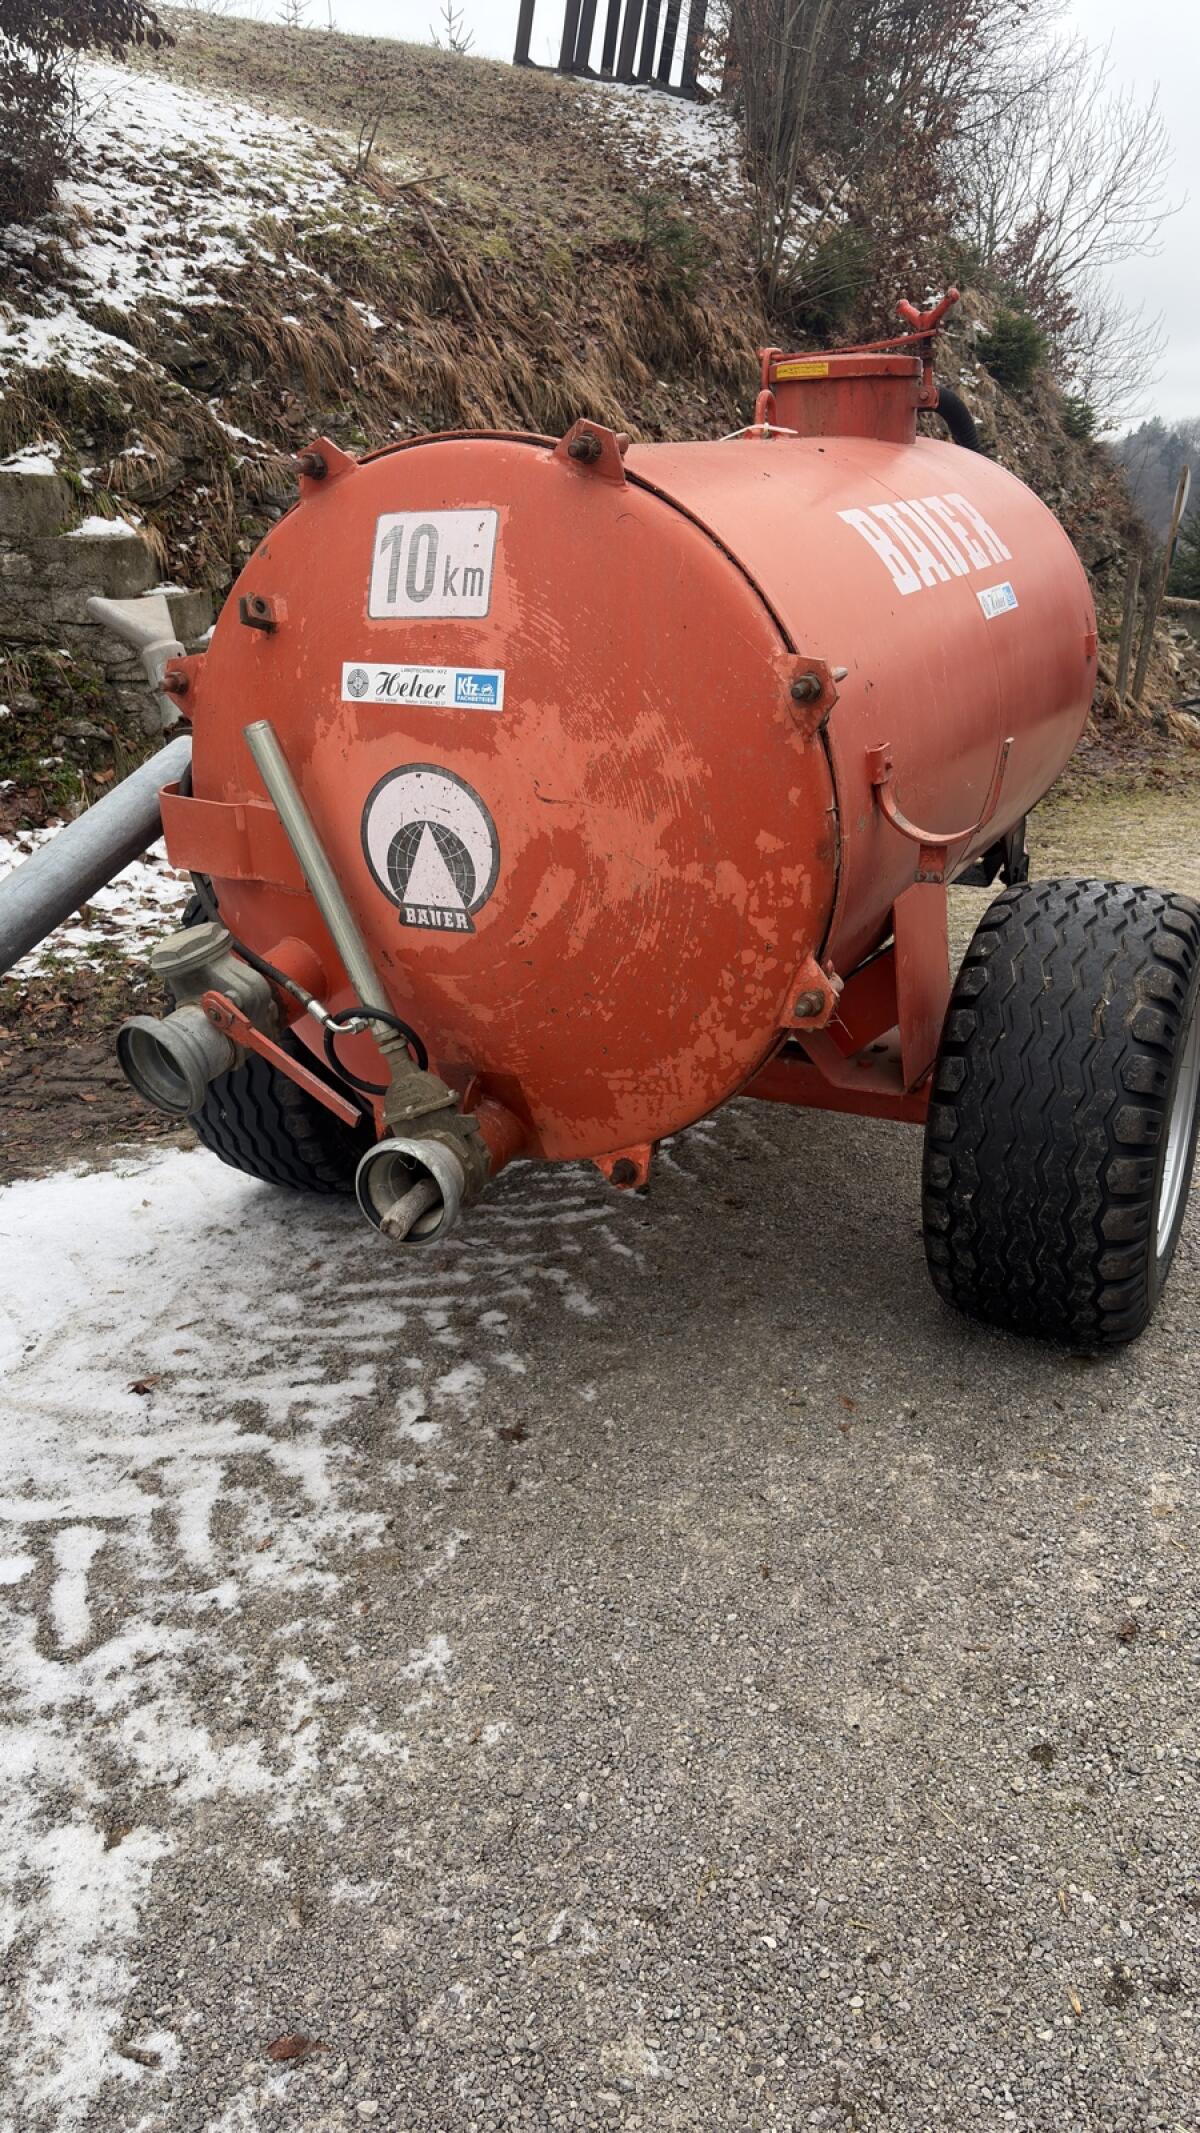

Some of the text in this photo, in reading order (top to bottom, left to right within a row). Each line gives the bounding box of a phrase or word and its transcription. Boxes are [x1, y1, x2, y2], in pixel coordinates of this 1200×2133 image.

[380, 523, 485, 603] 10 km
[836, 493, 1012, 595] BAUER
[457, 676, 476, 696] Kfz
[405, 907, 469, 929] BAUER
